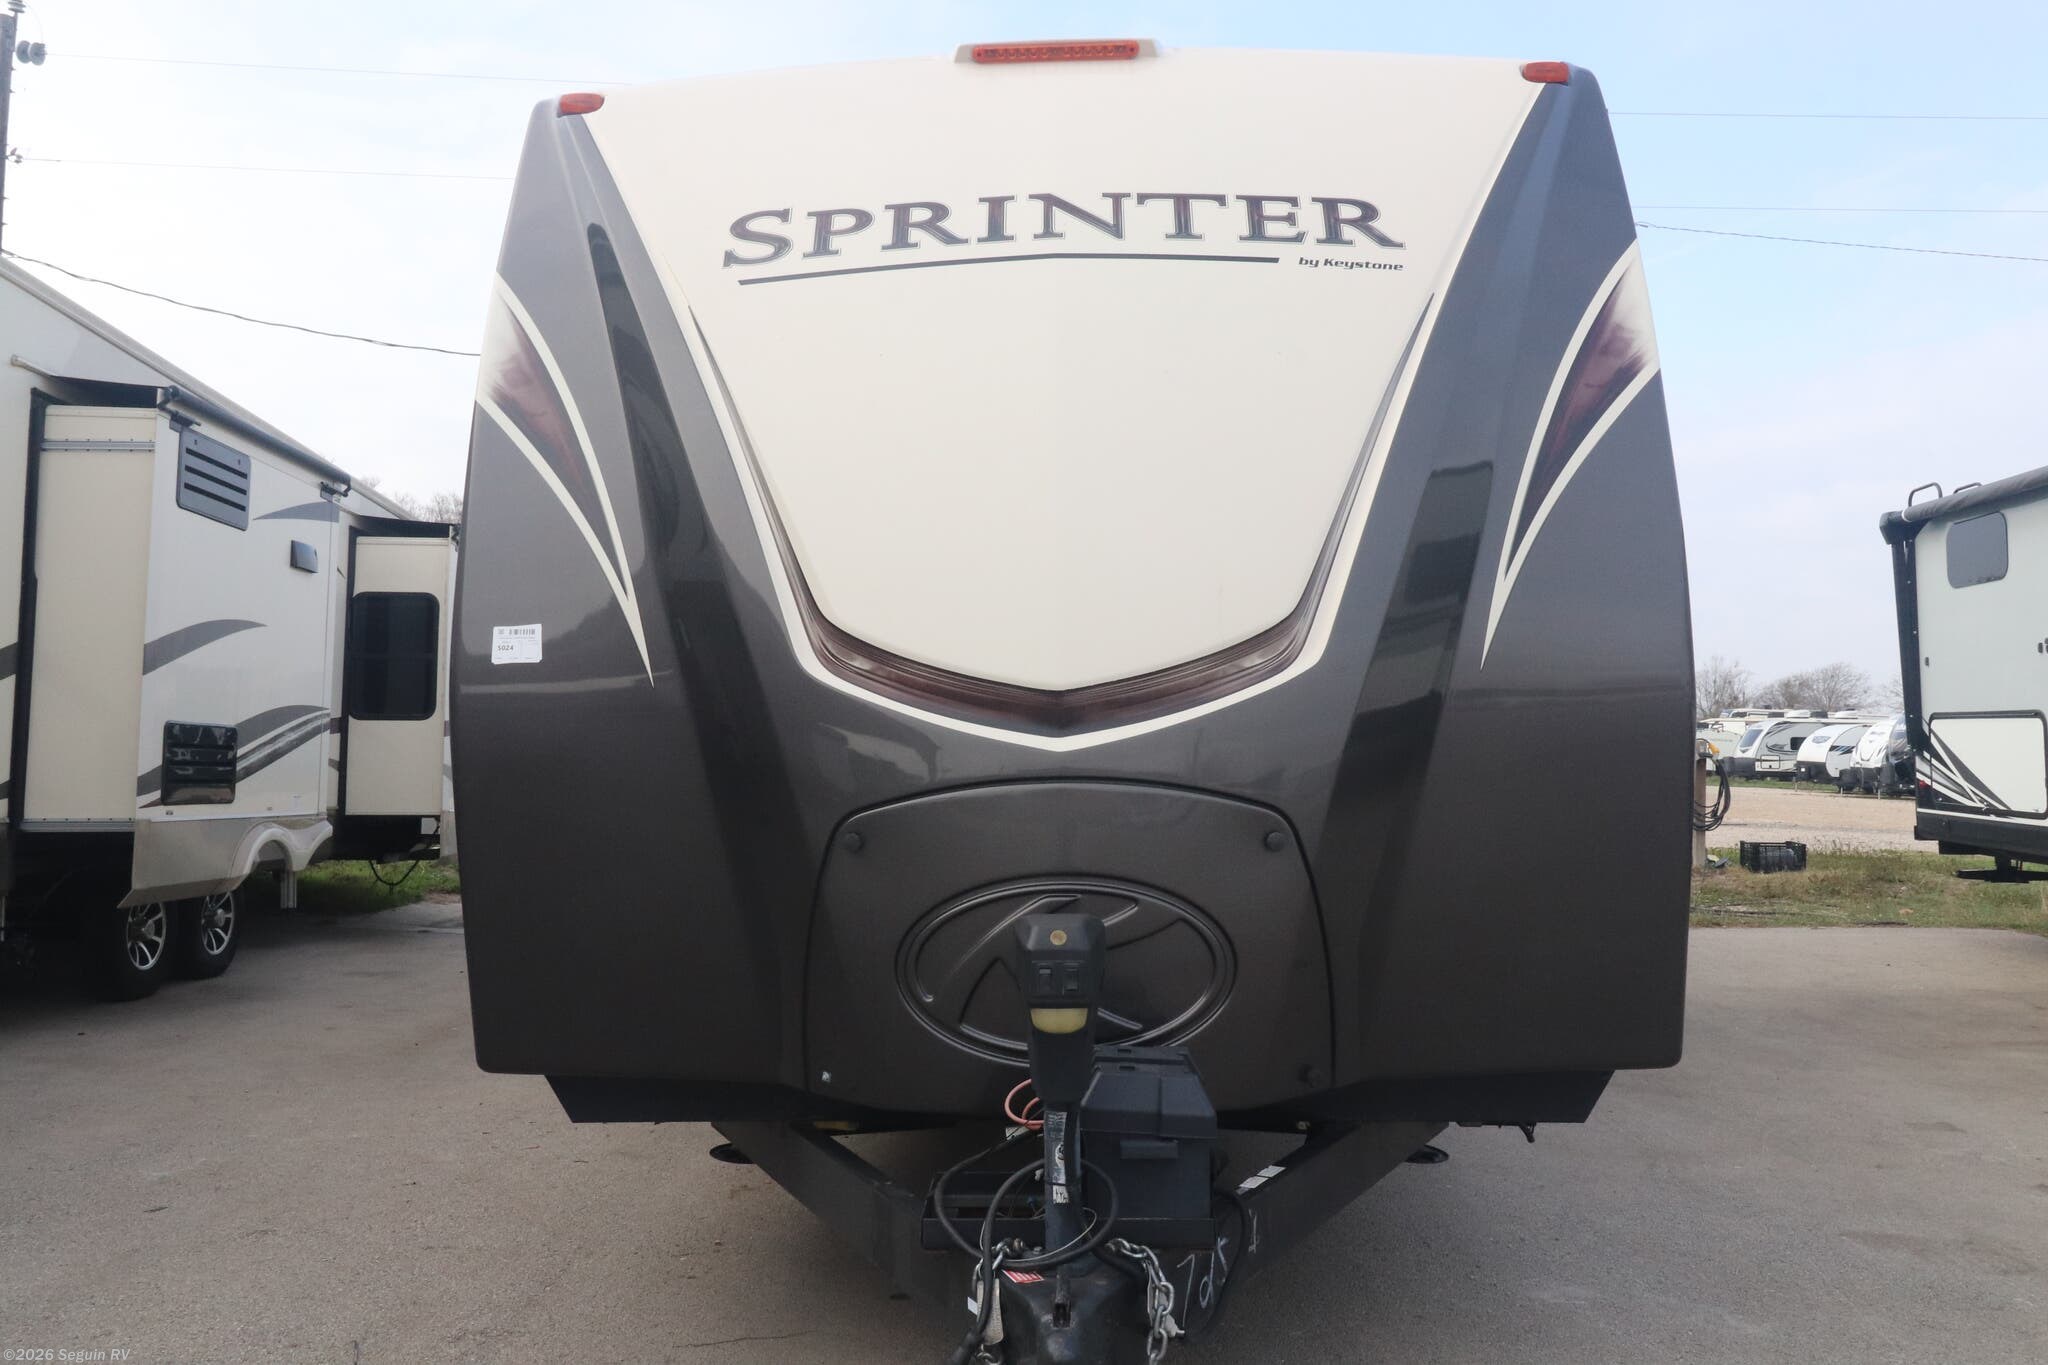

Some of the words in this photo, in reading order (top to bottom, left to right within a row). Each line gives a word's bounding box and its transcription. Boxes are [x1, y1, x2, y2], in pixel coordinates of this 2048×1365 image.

[723, 192, 1407, 269] SPRINTER
[1299, 257, 1320, 268] by
[1323, 258, 1404, 271] Keystone
